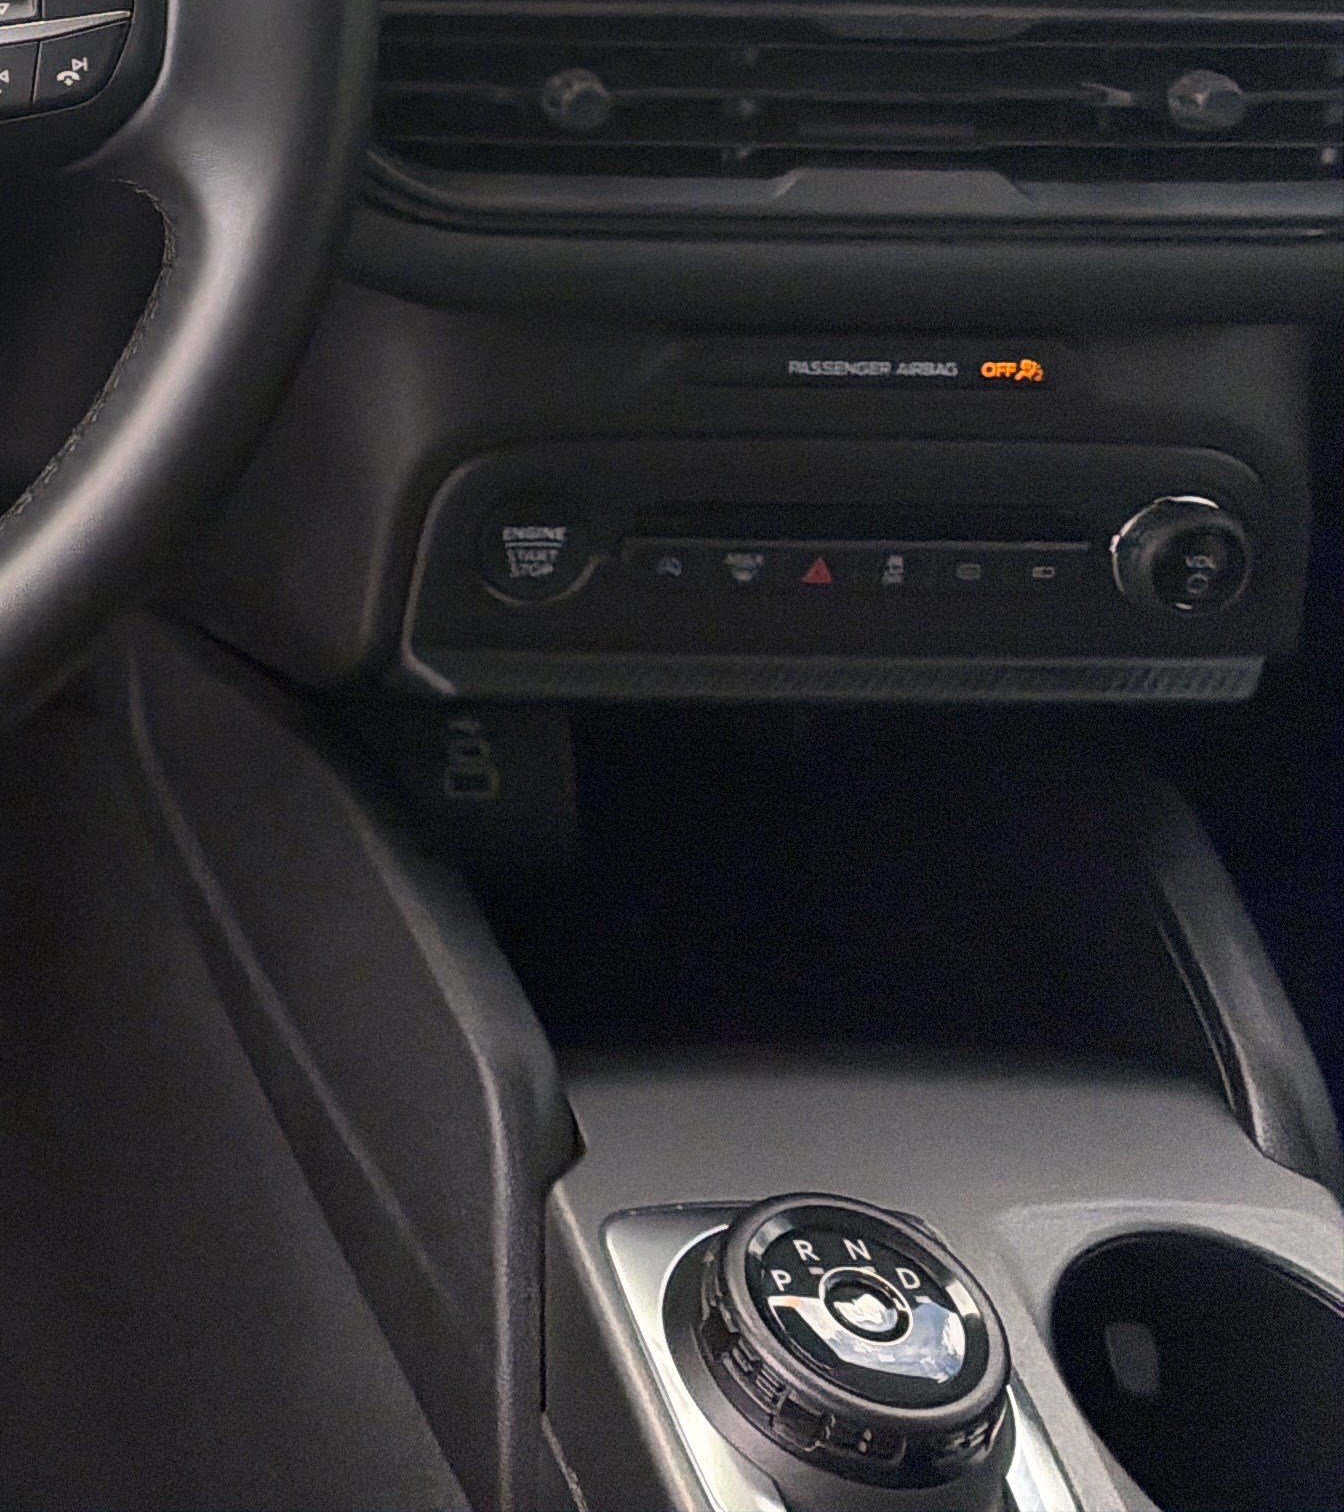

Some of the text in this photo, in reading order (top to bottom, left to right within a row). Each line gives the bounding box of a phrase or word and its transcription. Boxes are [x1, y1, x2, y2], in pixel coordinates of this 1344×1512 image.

[788, 360, 1017, 378] PASSENGER AIRBAG OFF
[792, 1238, 820, 1261] R
[843, 1238, 872, 1260] N
[770, 1269, 792, 1292] P
[893, 1267, 921, 1289] D
